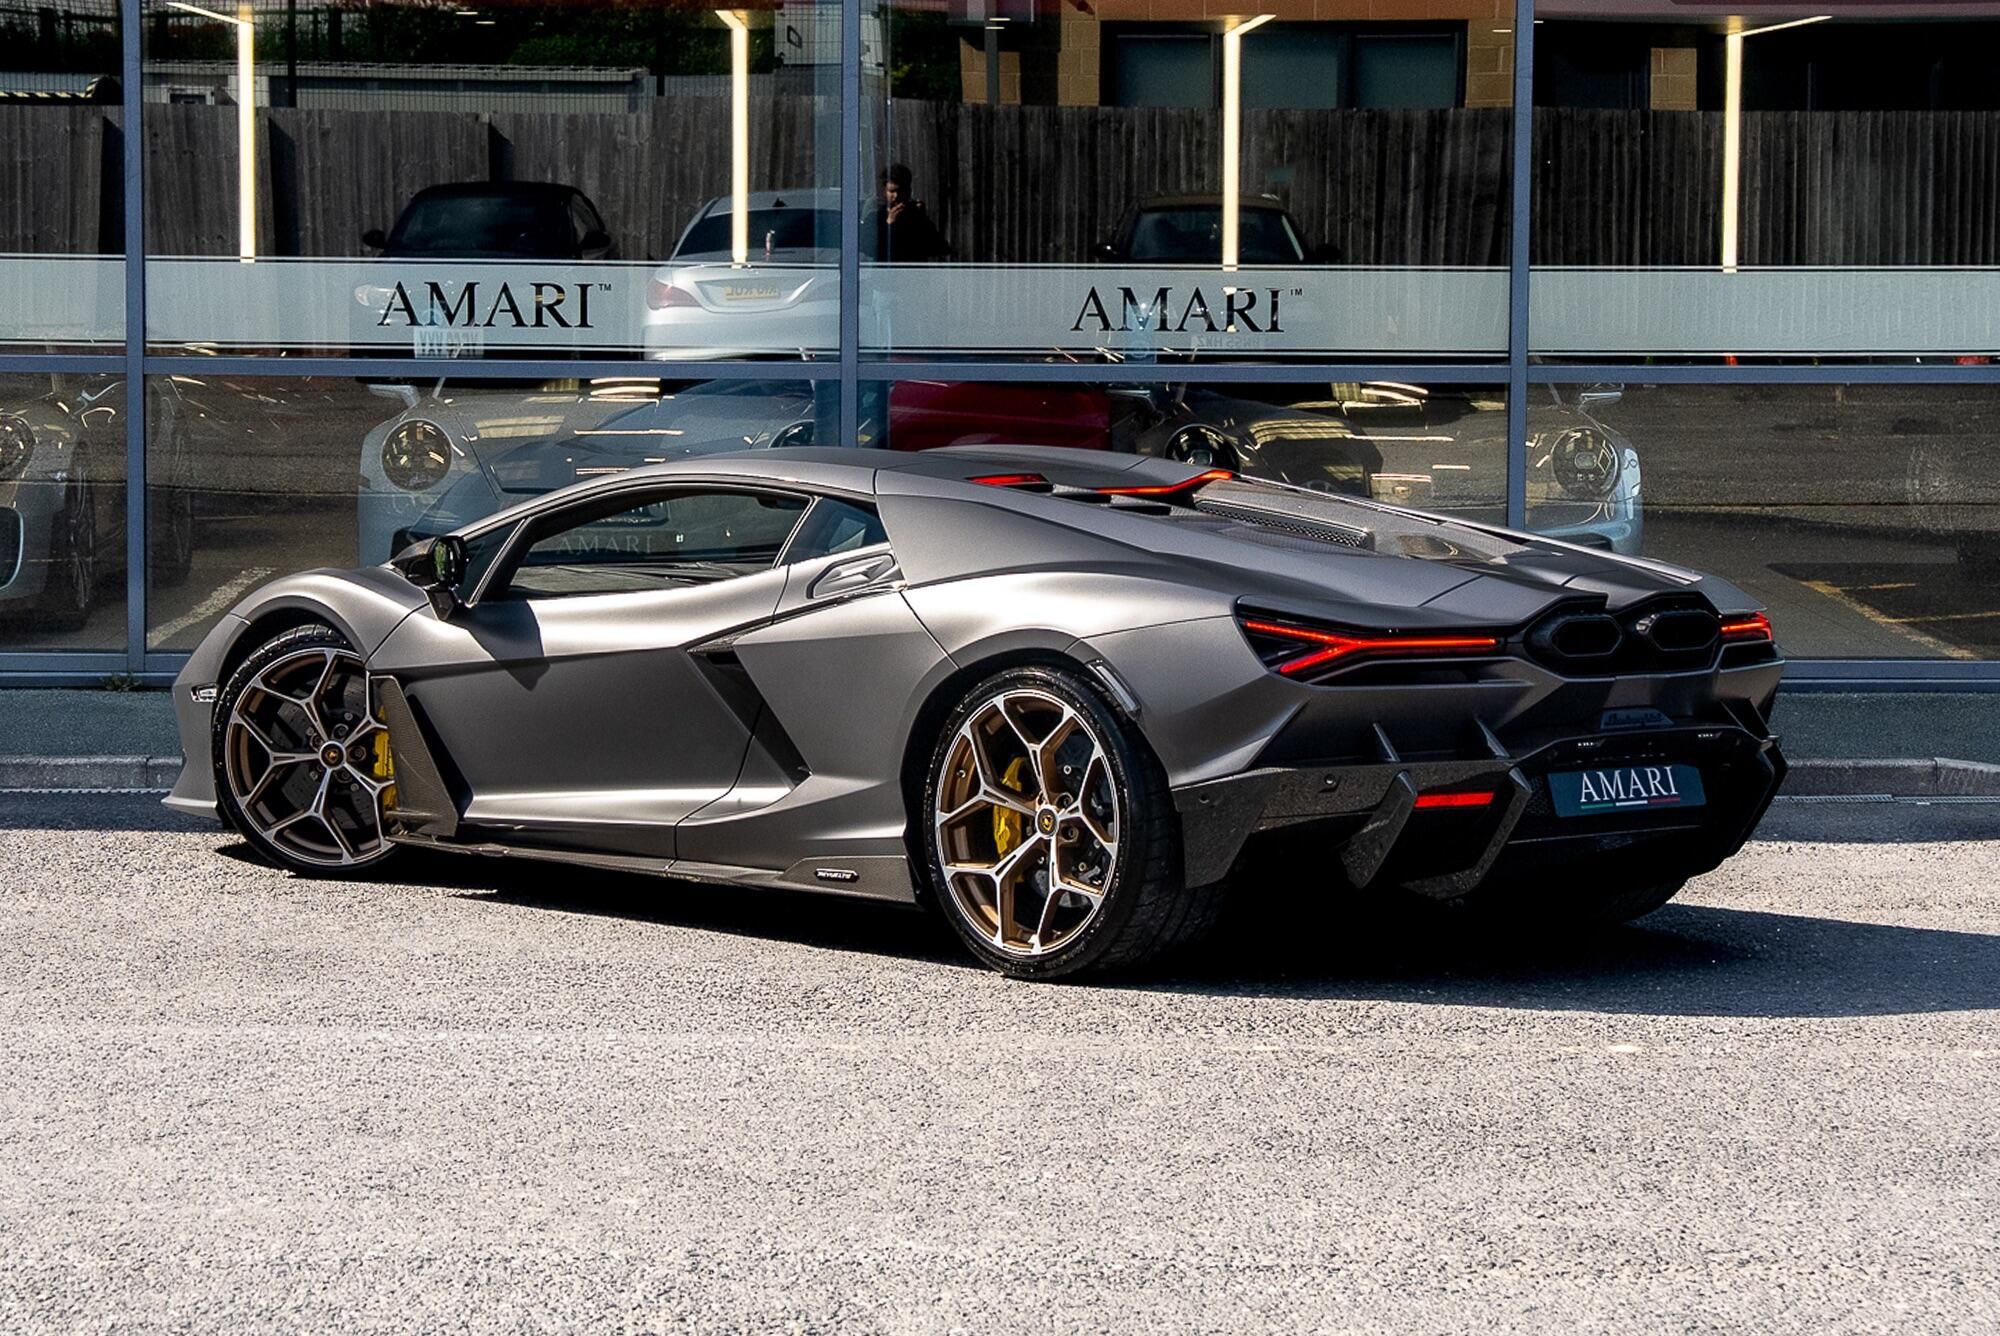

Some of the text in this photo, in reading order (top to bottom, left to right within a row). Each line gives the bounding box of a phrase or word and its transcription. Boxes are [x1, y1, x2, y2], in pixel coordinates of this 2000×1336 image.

[377, 280, 595, 328] AMARI
[1070, 286, 1284, 332] AMARI
[556, 534, 652, 555] AMARI
[1580, 766, 1678, 802] AMARI
